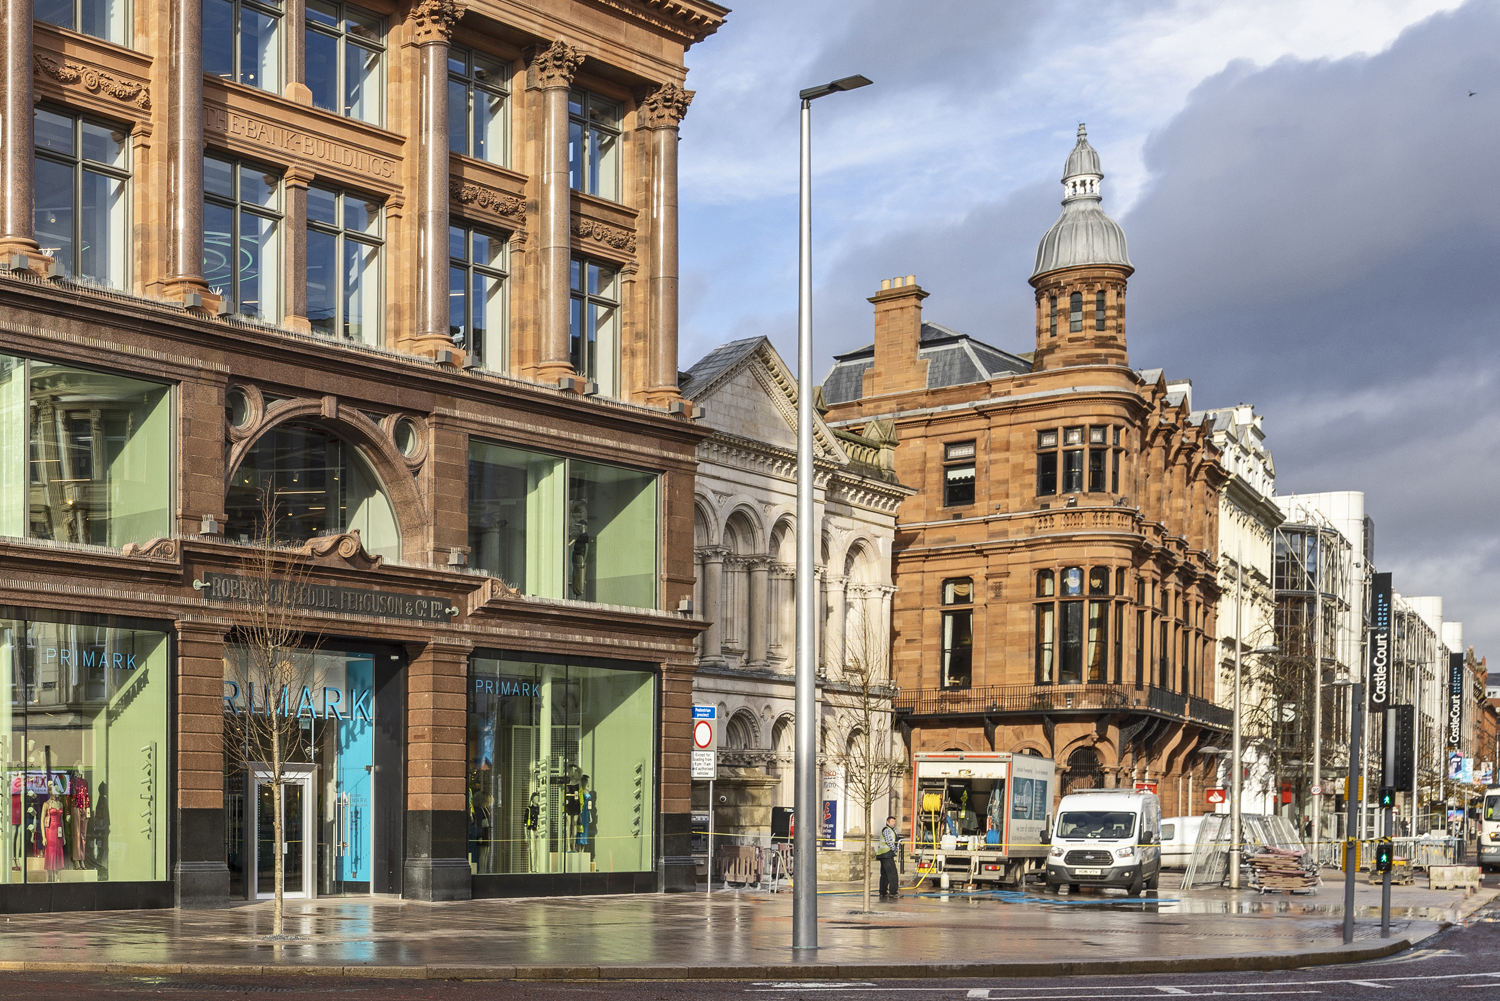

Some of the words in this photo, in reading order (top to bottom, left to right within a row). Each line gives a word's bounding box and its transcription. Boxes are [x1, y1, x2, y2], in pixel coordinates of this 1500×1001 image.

[340, 591, 403, 615] FERGUSON
[405, 601, 413, 616] &
[46, 648, 137, 670] PRIMARK
[1372, 633, 1388, 703] CastleCourt
[475, 679, 540, 697] PRIMARK
[1449, 694, 1461, 744] CastleCourt
